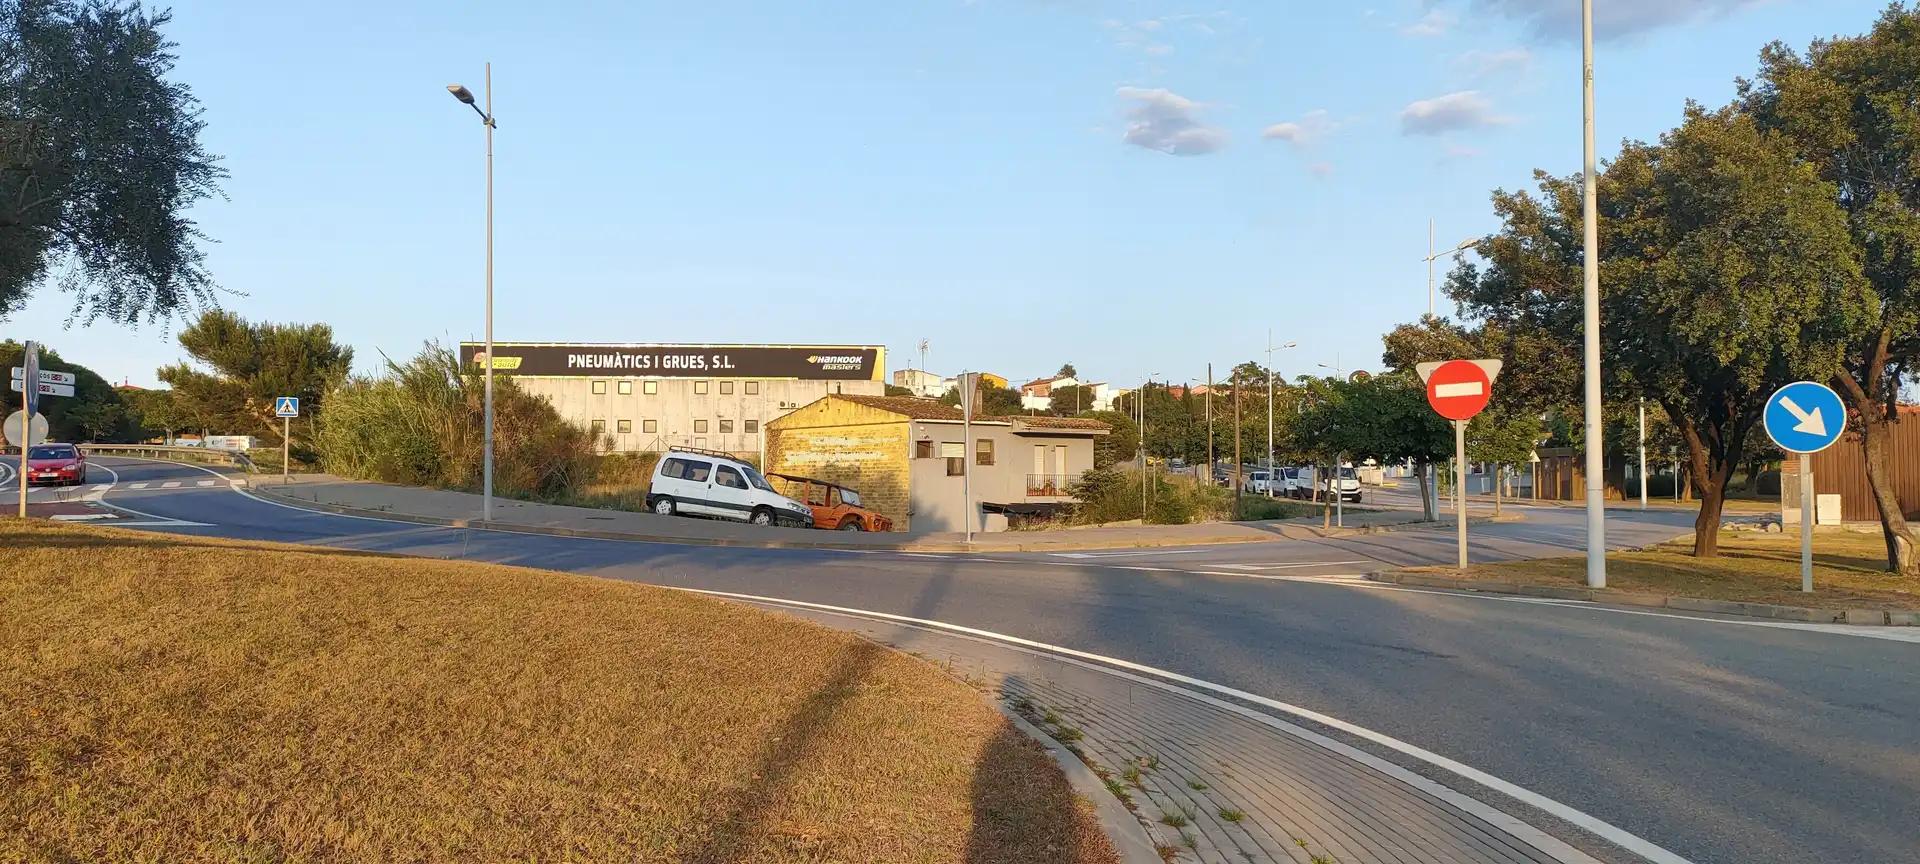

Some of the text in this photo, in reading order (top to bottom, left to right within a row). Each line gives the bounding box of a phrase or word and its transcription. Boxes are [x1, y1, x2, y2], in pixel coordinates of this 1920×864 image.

[568, 352, 735, 371] PNEUMÀTICS I GRUES, S.L.
